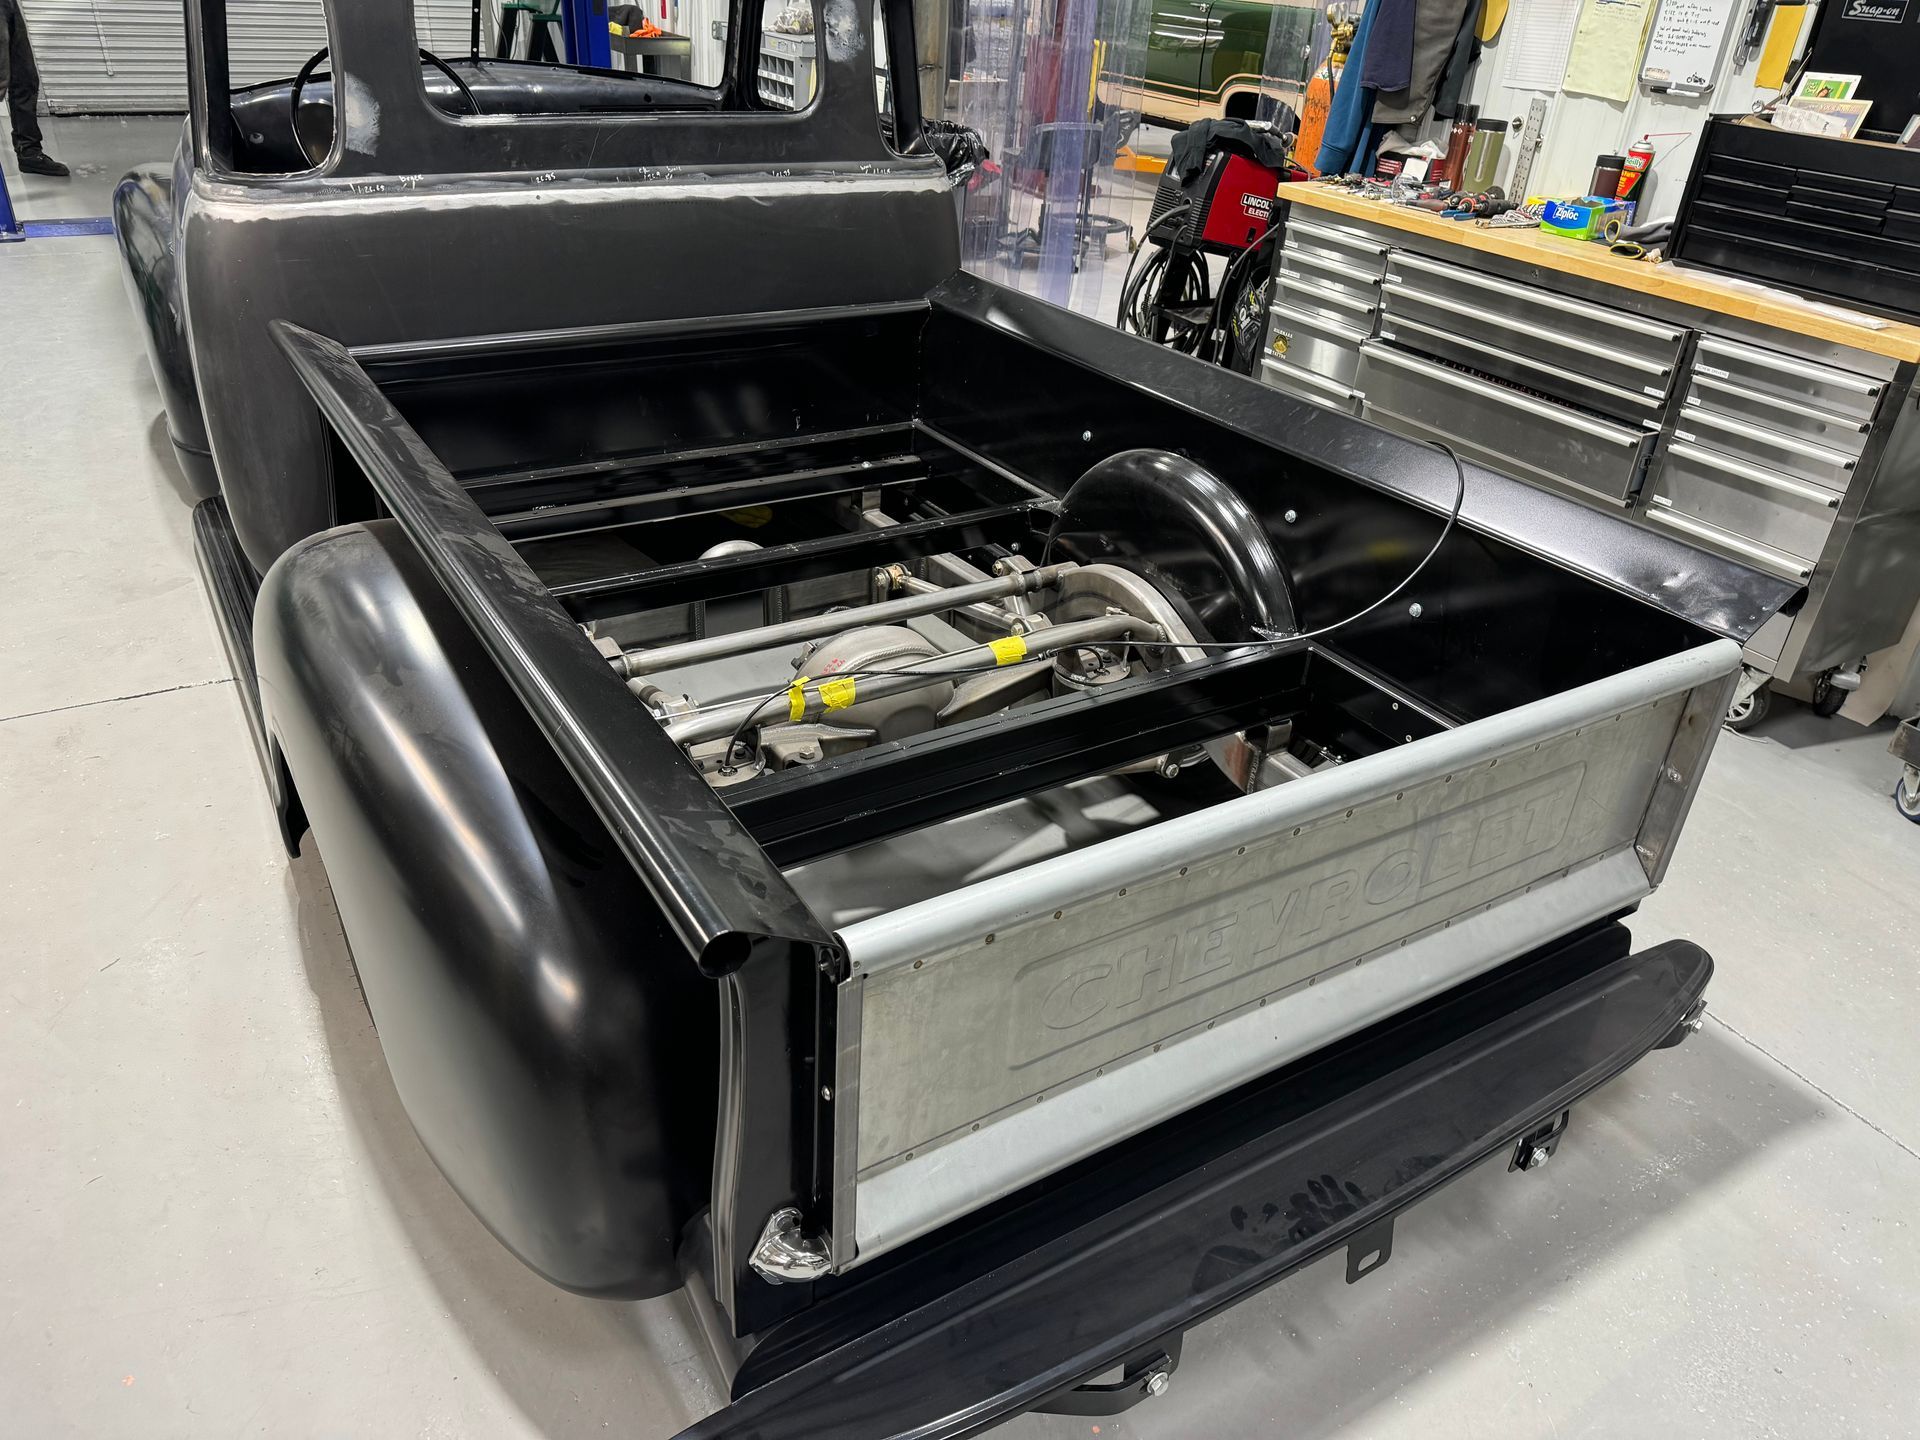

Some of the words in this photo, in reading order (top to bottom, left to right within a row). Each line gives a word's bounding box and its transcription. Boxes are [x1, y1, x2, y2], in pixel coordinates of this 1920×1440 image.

[1848, 0, 1901, 18] Snap-on
[1556, 206, 1579, 221] Ziploc
[1040, 787, 1566, 1031] CHEVROLET
